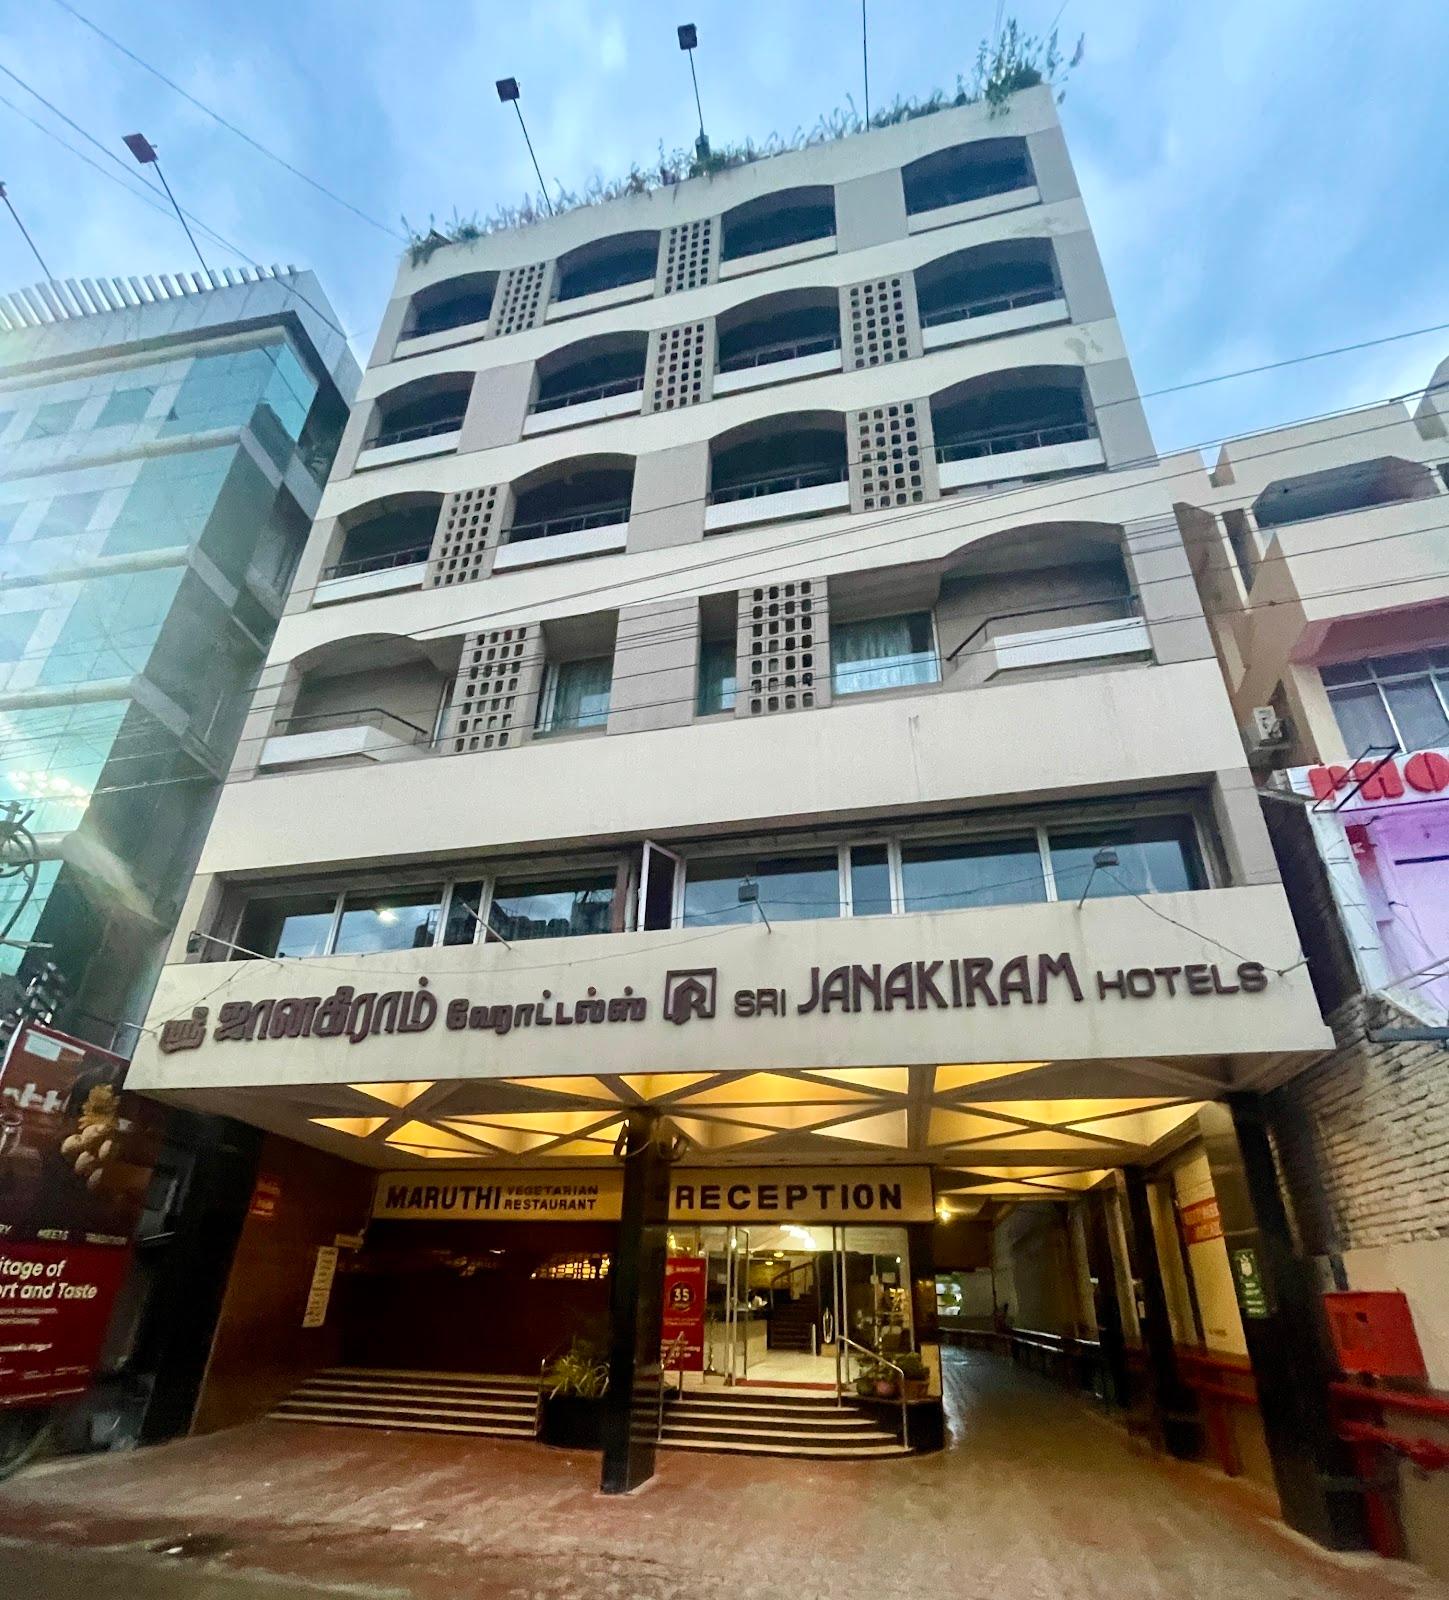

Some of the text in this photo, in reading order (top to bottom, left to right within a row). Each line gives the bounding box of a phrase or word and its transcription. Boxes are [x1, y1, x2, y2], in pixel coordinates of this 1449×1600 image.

[734, 952, 1267, 1018] SRI JANAKIRAM HOTELS
[385, 1185, 500, 1210] MARUTHI
[507, 1185, 598, 1196] VEGETARIAN
[675, 1183, 902, 1210] RECEPTION
[504, 1198, 597, 1210] RESTAURANT
[46, 1259, 67, 1278] of
[20, 1282, 55, 1299] and
[58, 1282, 98, 1300] Taste
